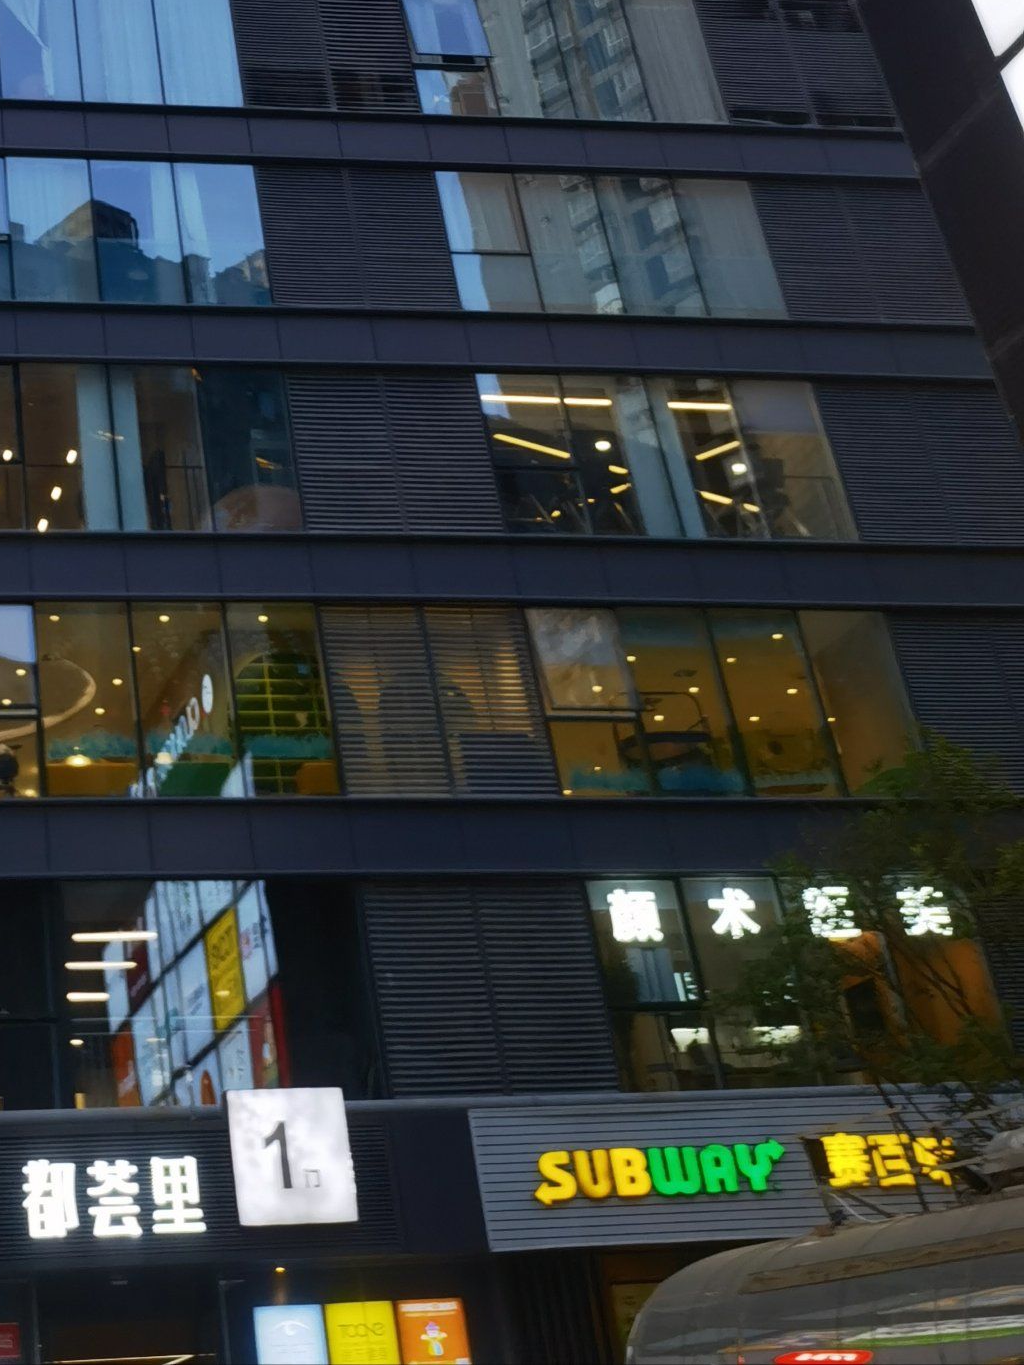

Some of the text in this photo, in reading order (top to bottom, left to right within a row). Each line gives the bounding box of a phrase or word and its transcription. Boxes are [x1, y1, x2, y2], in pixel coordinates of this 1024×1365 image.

[22, 1155, 208, 1239] 都荟里
[534, 1138, 785, 1206] SUBWAY
